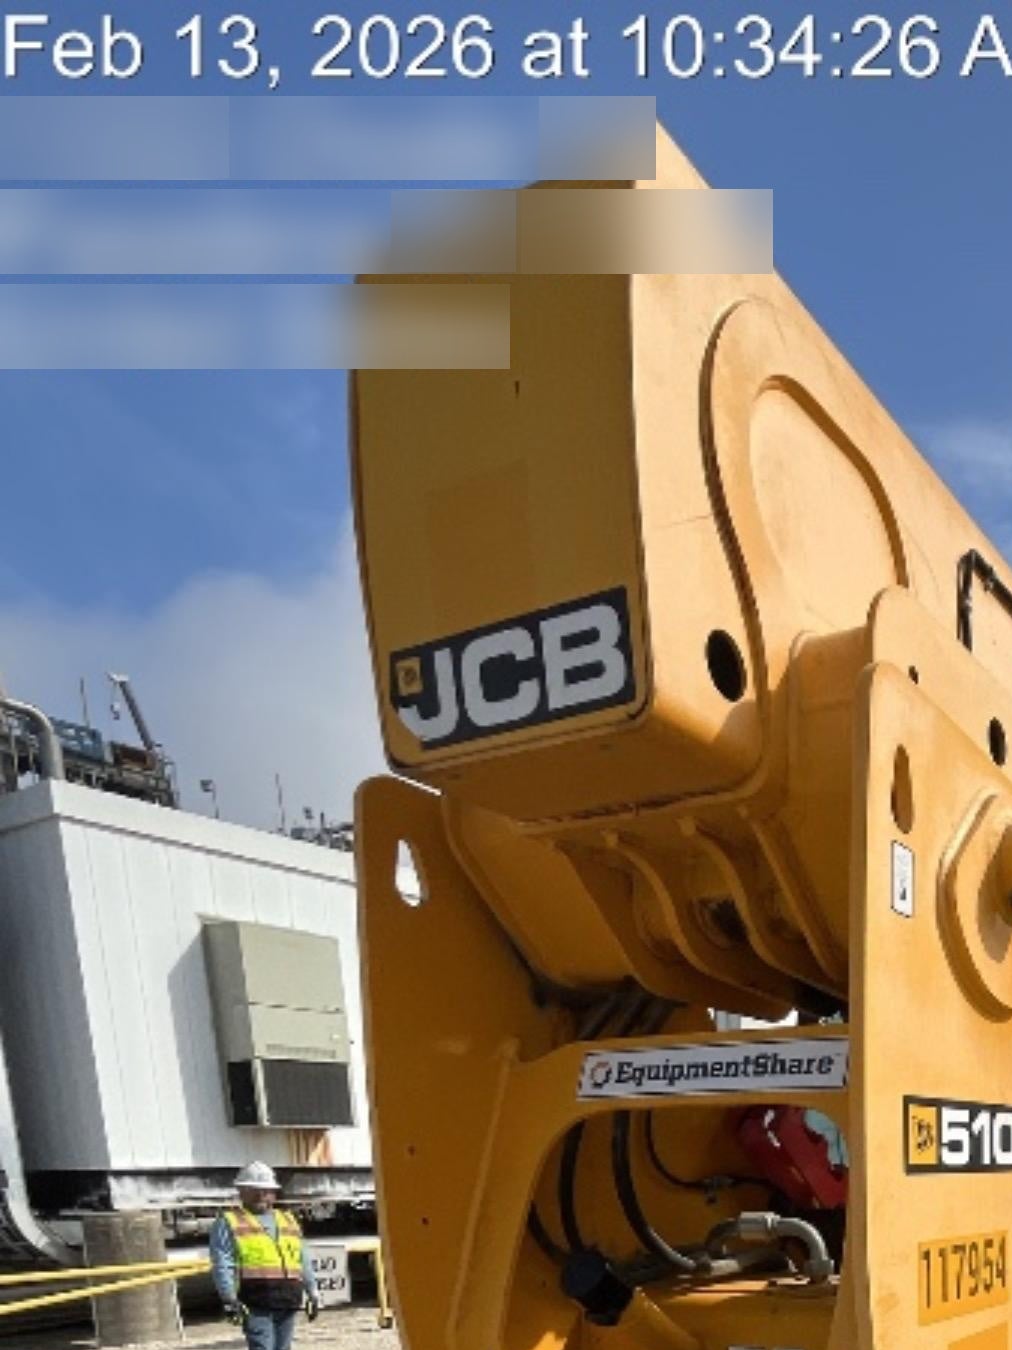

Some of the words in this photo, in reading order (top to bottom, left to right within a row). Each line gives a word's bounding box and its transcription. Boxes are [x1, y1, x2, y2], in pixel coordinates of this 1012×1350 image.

[398, 602, 628, 741] JCB
[614, 1052, 836, 1087] EquipmentShare
[922, 1236, 1007, 1309] 117954
